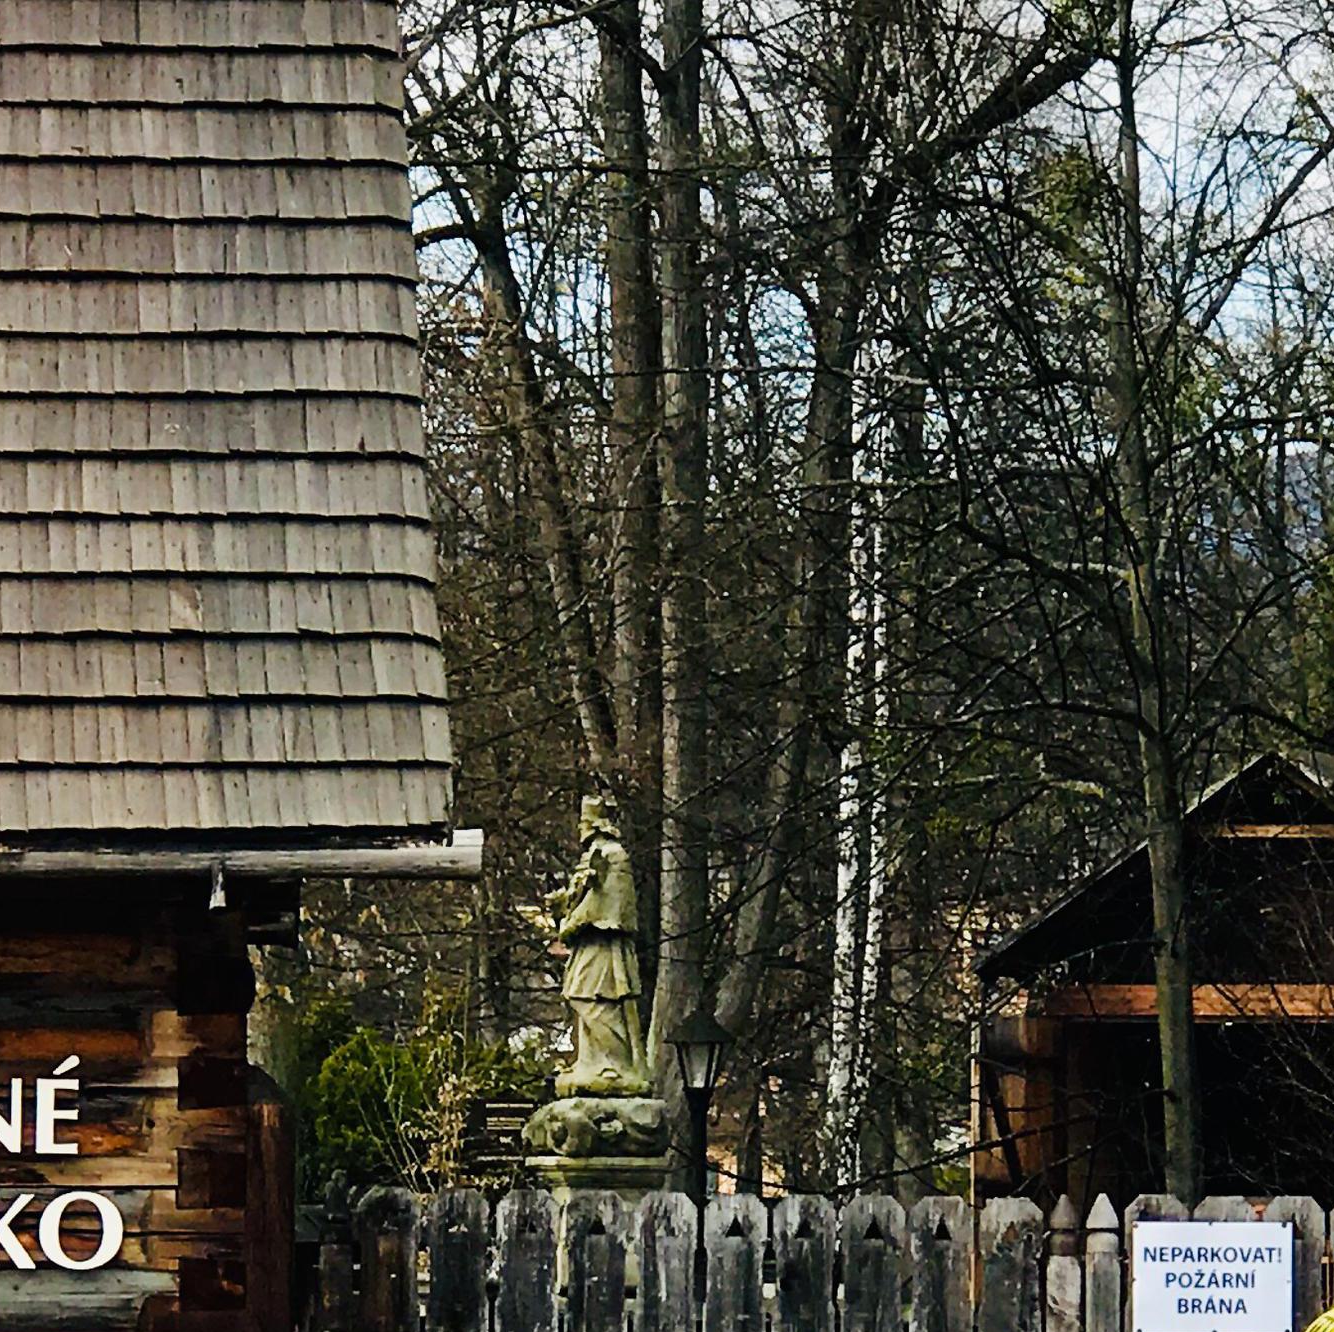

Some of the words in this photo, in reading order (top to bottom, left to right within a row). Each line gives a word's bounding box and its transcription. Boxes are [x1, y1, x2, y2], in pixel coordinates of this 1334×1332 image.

[1142, 1246, 1283, 1264] NEPARKOVAT!
[1164, 1269, 1256, 1289] POŽÁRNÍ
[1176, 1297, 1248, 1315] BRÁNA
